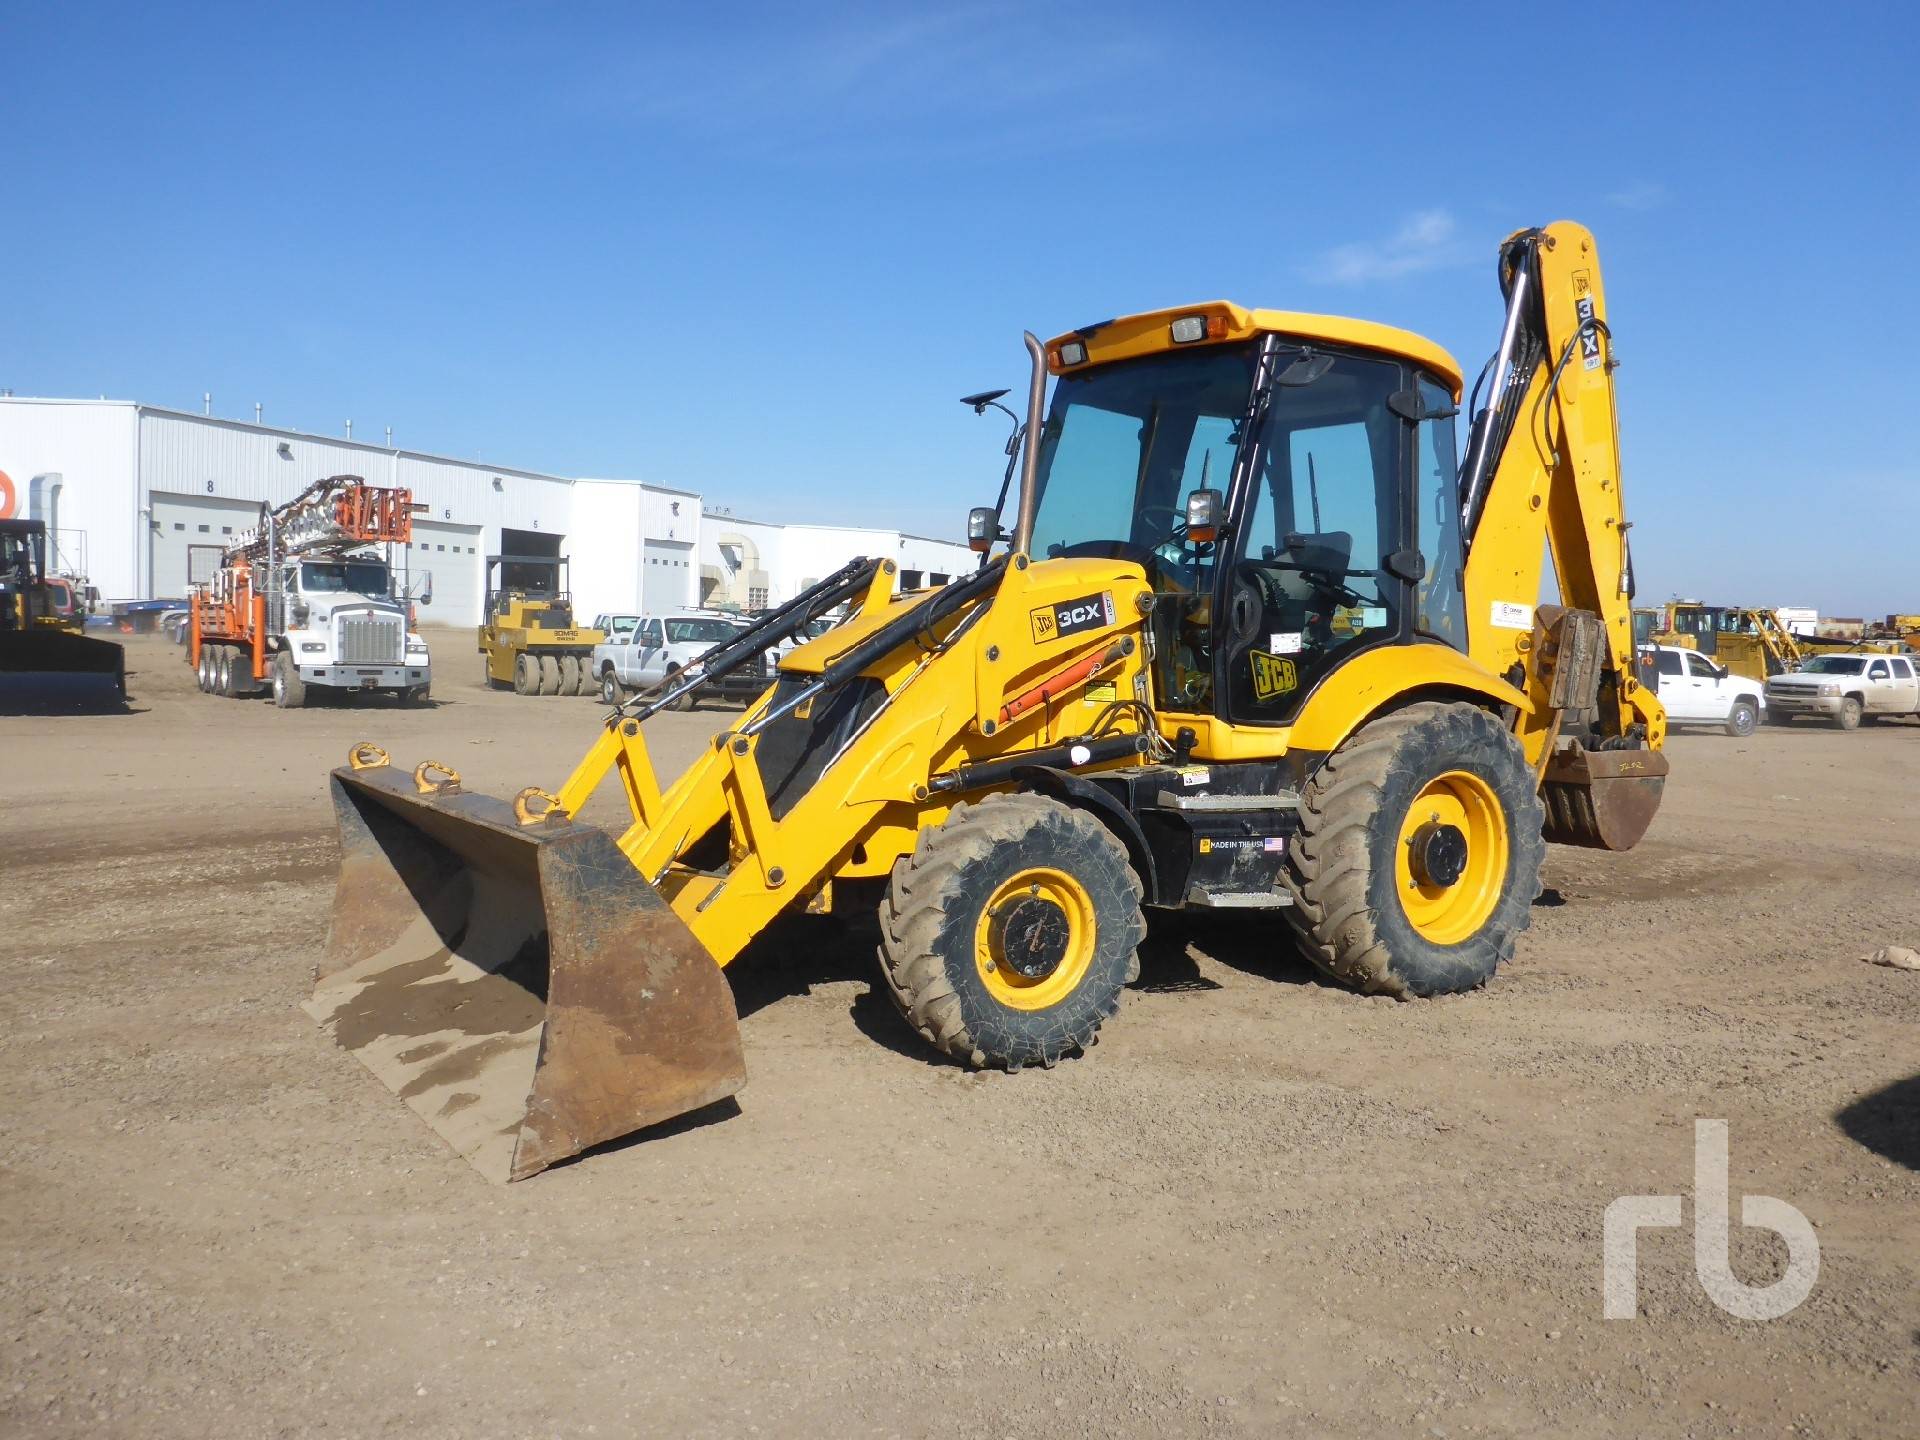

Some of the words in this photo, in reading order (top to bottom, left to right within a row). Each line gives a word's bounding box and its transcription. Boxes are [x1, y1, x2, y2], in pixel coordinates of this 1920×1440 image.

[207, 480, 214, 493] 8
[445, 509, 451, 519] 6
[533, 520, 538, 528] 5
[1036, 616, 1054, 633] JCB
[1058, 602, 1101, 628] 3CX
[1258, 656, 1294, 693] JCB
[1210, 841, 1229, 849] MADE
